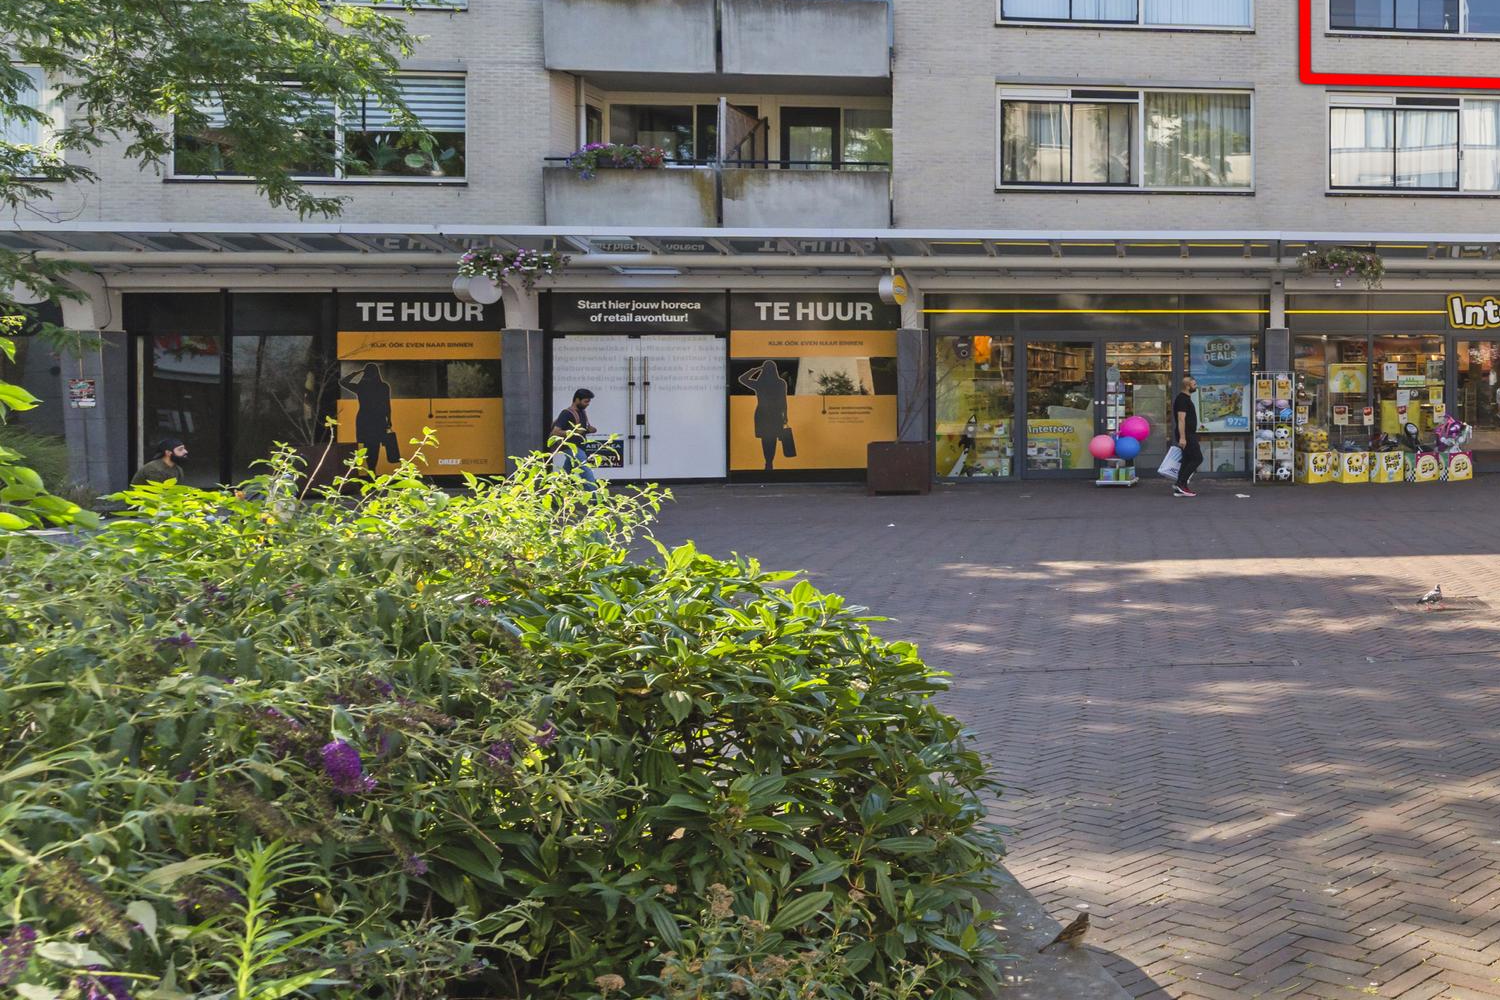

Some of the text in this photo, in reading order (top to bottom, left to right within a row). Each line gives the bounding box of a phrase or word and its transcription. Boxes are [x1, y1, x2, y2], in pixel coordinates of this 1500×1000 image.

[577, 300, 701, 311] Start hier jouw horeca
[356, 301, 484, 322] TE HUUR
[754, 302, 873, 321] TE HUUR
[590, 312, 689, 322] of retail avontuur!
[1205, 343, 1231, 352] LEGO
[1203, 351, 1237, 361] DEALS
[1028, 424, 1074, 434] Intertoys
